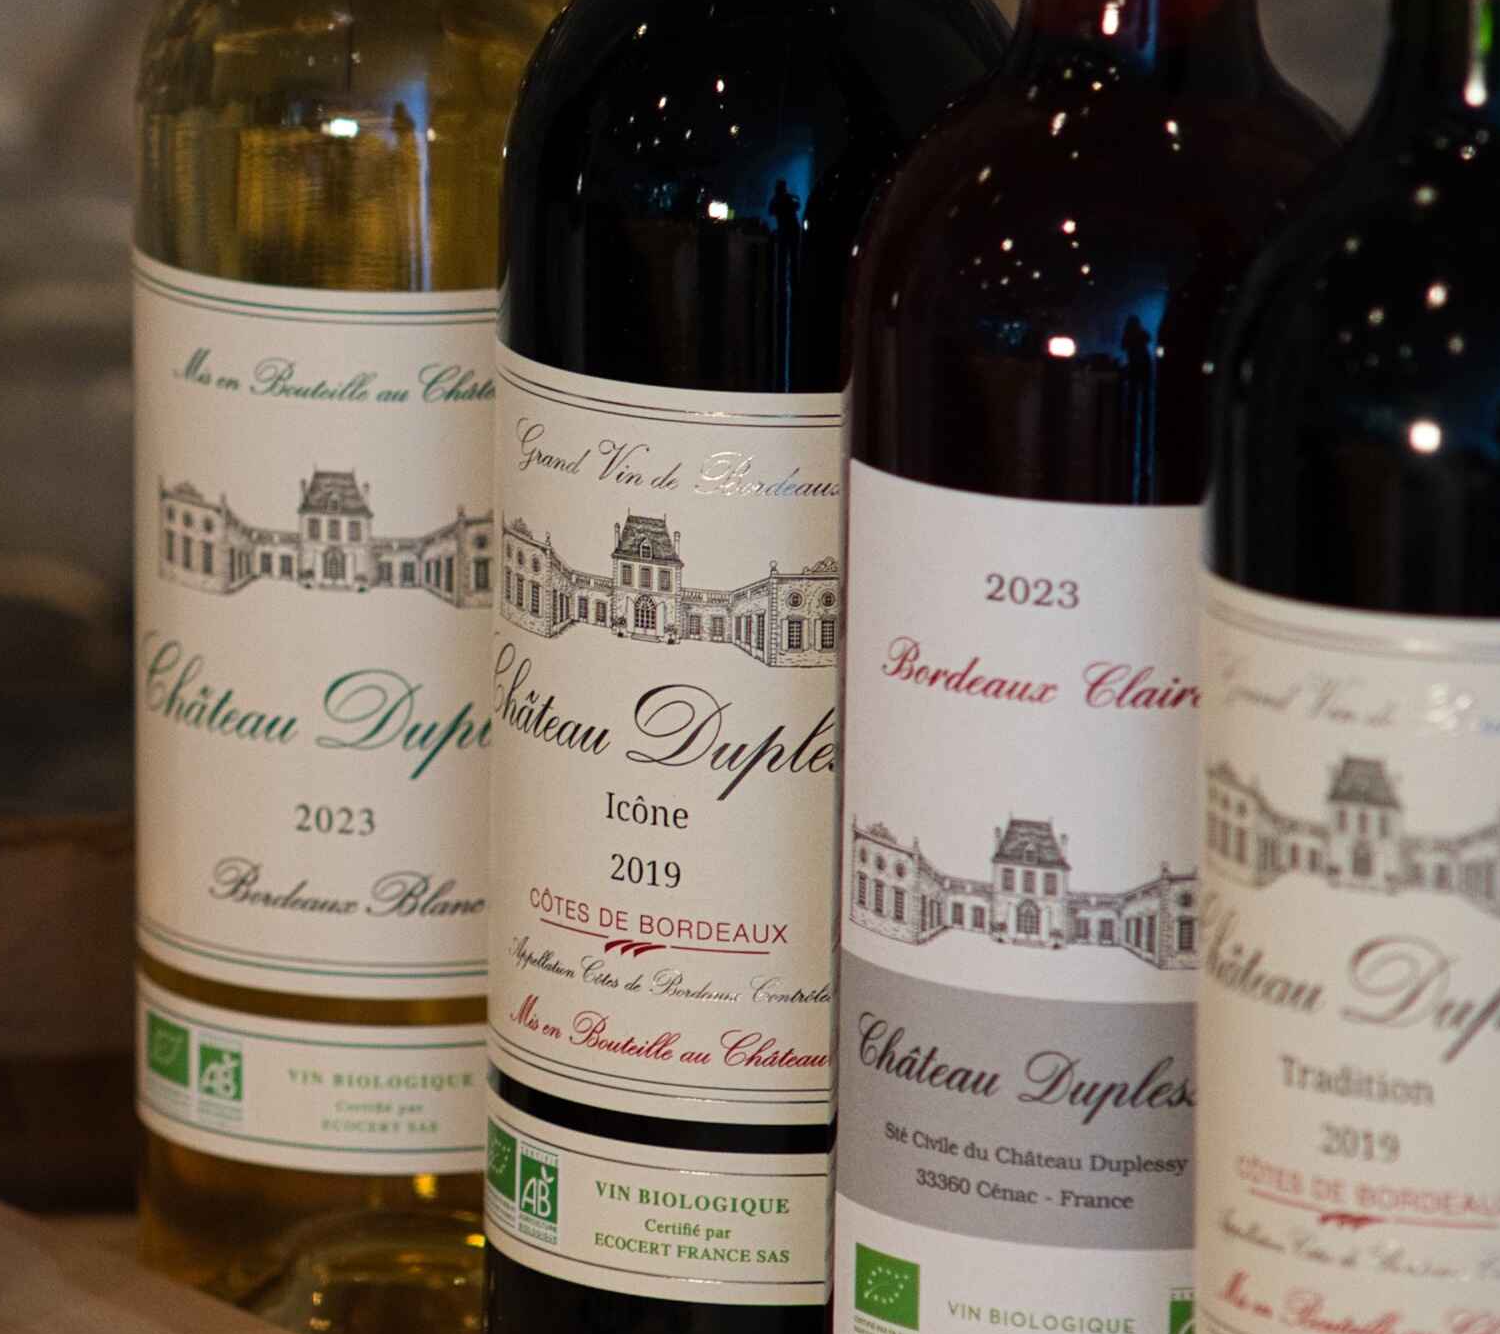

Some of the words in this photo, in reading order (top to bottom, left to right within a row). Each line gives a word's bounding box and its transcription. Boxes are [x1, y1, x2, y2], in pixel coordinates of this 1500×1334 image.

[215, 375, 241, 392] en
[250, 357, 377, 403] Bouteille
[376, 387, 409, 404] au
[515, 416, 592, 476] Grand
[597, 438, 650, 488] Vin
[650, 463, 683, 491] de
[984, 572, 1081, 610] 2023
[141, 630, 299, 745] Château
[881, 635, 1060, 705] Bordeaux
[625, 683, 837, 802] Duple
[294, 803, 377, 837] 2023
[604, 791, 690, 830] Icône
[208, 856, 358, 916] Bordeaux
[364, 870, 488, 918] Blanc
[609, 853, 682, 890] 2019
[529, 887, 591, 925] CÔTES
[598, 908, 630, 932] DE
[638, 914, 789, 946] BORDEAUX
[508, 935, 578, 980] Appellation
[580, 953, 620, 990] Côtes
[623, 974, 643, 994] de
[648, 968, 744, 1004] Bordeaux
[508, 993, 541, 1033] Mis
[542, 1020, 562, 1040] en
[568, 1010, 682, 1062] Bouteille
[679, 1047, 712, 1066] au
[721, 1028, 832, 1068] Château
[857, 1011, 1000, 1099] Château
[1279, 1053, 1437, 1107] Tradition
[911, 1128, 960, 1157] Civile
[963, 1140, 990, 1163] du
[995, 1143, 1083, 1172] Château
[1088, 1153, 1189, 1178] Duplessy
[1320, 1122, 1402, 1164] 2019
[521, 1176, 552, 1218] AB
[594, 1179, 632, 1202] VIN
[638, 1187, 791, 1216] BIOLOGIQUE
[915, 1167, 972, 1196] 33360
[976, 1179, 1039, 1206] Cénac
[1059, 1189, 1135, 1211] France
[1309, 1177, 1346, 1205] DE
[593, 1231, 672, 1258] ECOCERT
[676, 1241, 753, 1264] FRANCE
[756, 1247, 791, 1265] SAS
[643, 1218, 701, 1240] Certifié
[704, 1225, 732, 1242] par
[946, 1298, 983, 1325] VIN
